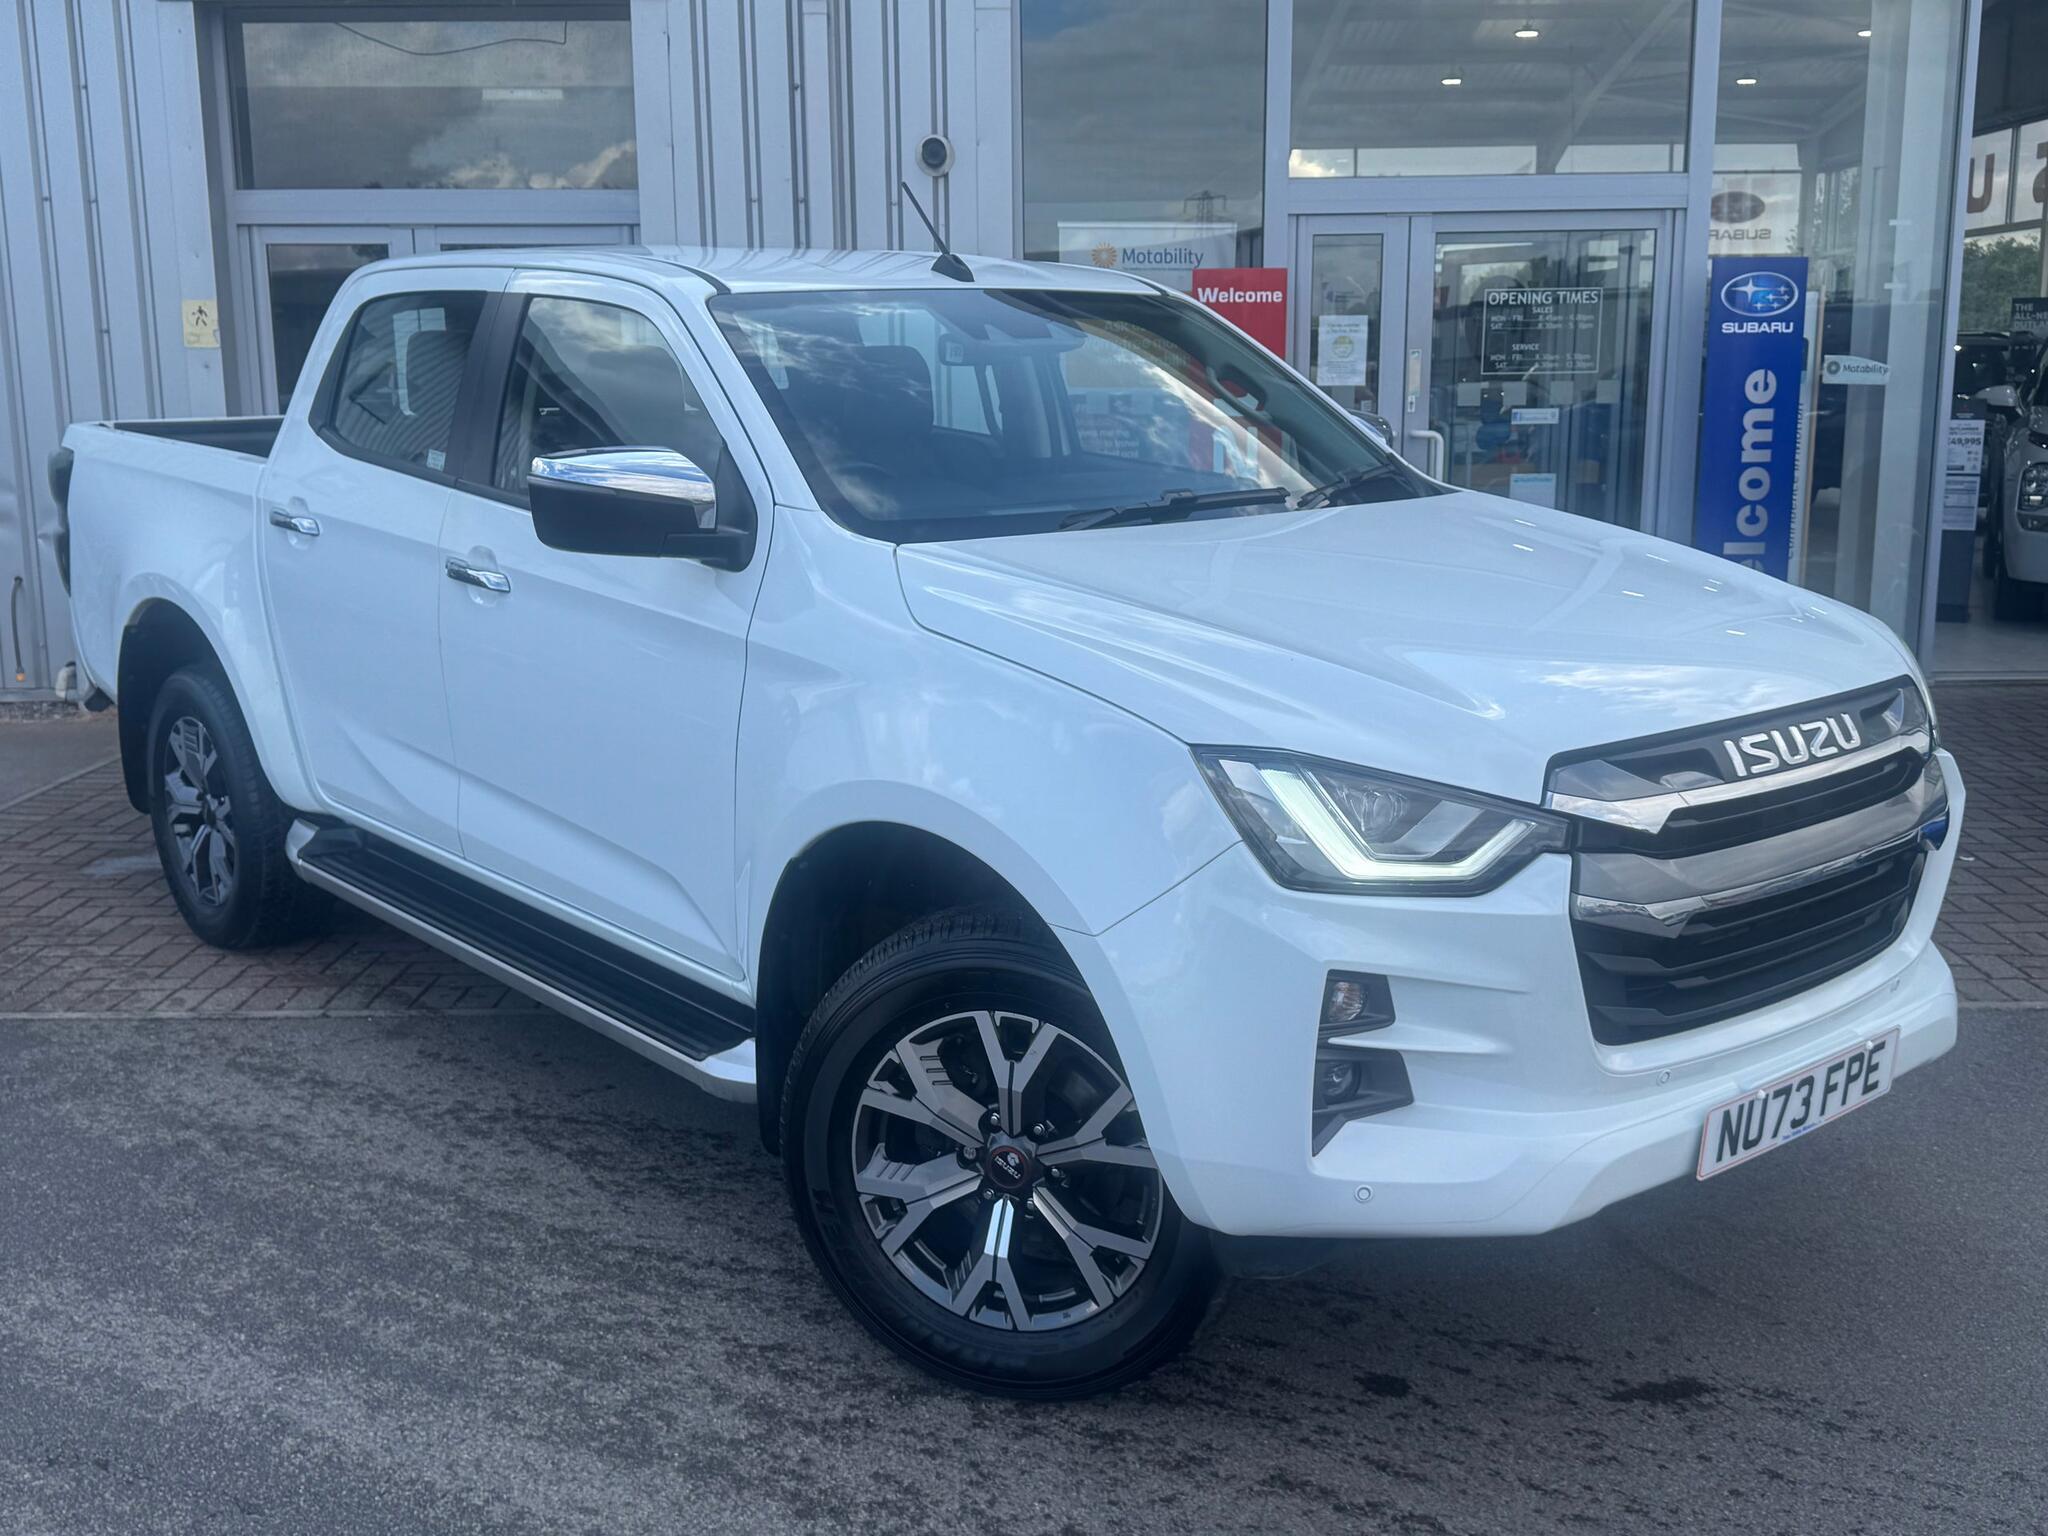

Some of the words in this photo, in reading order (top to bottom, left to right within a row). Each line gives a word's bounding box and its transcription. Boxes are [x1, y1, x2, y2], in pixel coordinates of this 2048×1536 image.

[1122, 247, 1204, 268] Motability
[1197, 287, 1283, 303] Welcome
[1488, 291, 1552, 305] OPENING
[1557, 290, 1599, 305] TIMES
[1532, 306, 1553, 314] SALES
[2015, 303, 2034, 312] THE
[1721, 322, 1794, 333] SUBARU
[1512, 343, 1539, 351] SERVICE
[1842, 363, 1889, 375] Motability
[1724, 713, 1862, 777] ISUZU
[1716, 1075, 1815, 1164] NU73
[1819, 1040, 1887, 1117] FPE
[994, 1155, 1021, 1179] ISUZU
